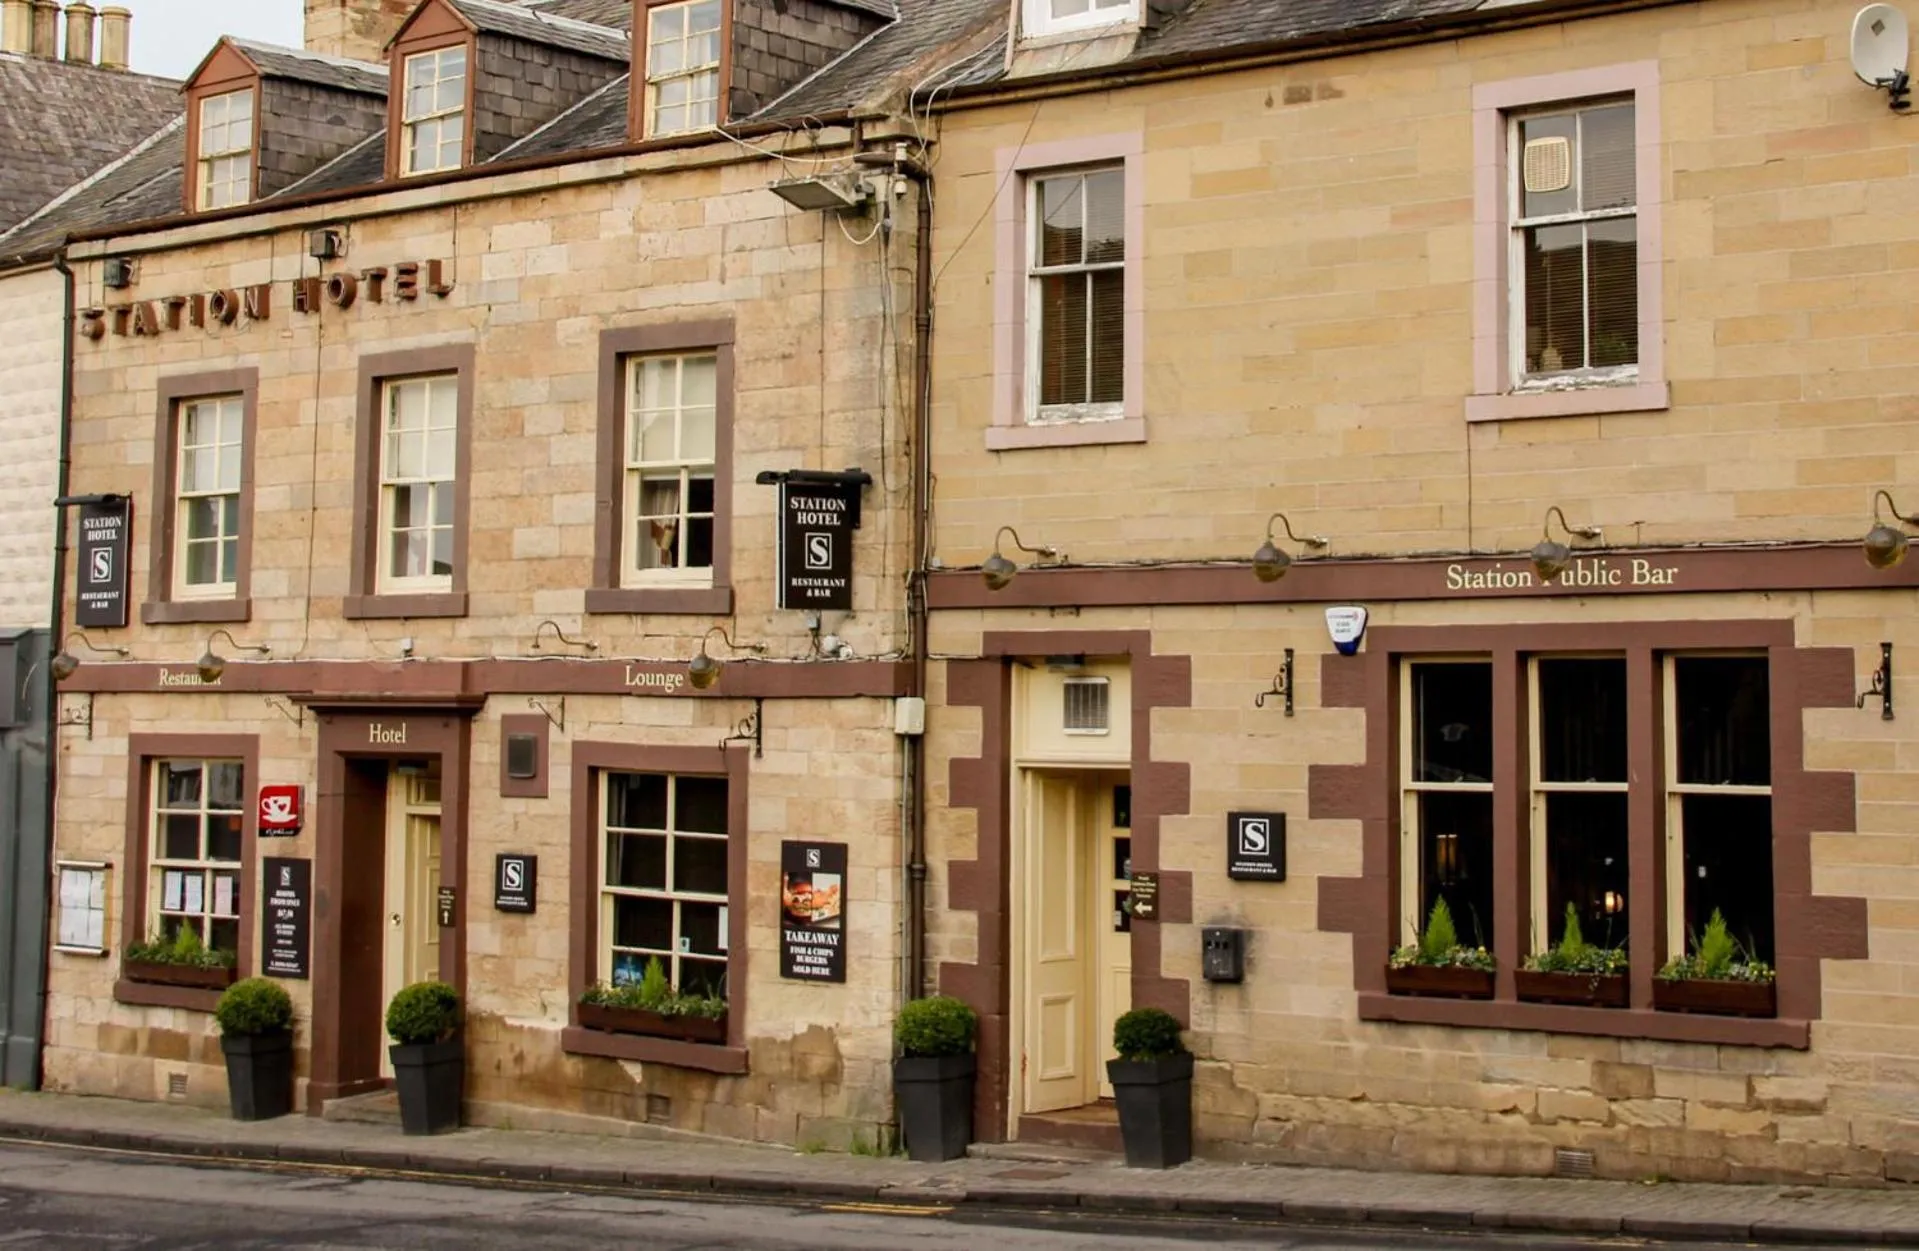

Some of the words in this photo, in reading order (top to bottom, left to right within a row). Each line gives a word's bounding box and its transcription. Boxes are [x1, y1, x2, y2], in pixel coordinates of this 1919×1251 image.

[81, 283, 271, 340] STATION
[292, 259, 455, 313] HOTEL
[790, 497, 846, 511] STATION
[84, 516, 121, 530] STATION
[797, 511, 840, 525] HOTEL
[87, 528, 117, 541] HOTEL
[810, 537, 828, 565] S
[94, 551, 110, 579] S
[791, 577, 845, 588] RESTAURANT
[1446, 563, 1533, 590] Station
[1542, 559, 1622, 587] ublic
[1631, 558, 1680, 585] Bar
[806, 588, 813, 598] &
[814, 588, 832, 598] BAR
[625, 665, 684, 693] Lounge
[369, 723, 406, 743] Hotel
[1245, 822, 1265, 851] S
[506, 862, 520, 887] S
[785, 930, 840, 945] TAKEAWAY
[791, 946, 806, 954] FISH
[813, 948, 833, 957] CHIPS
